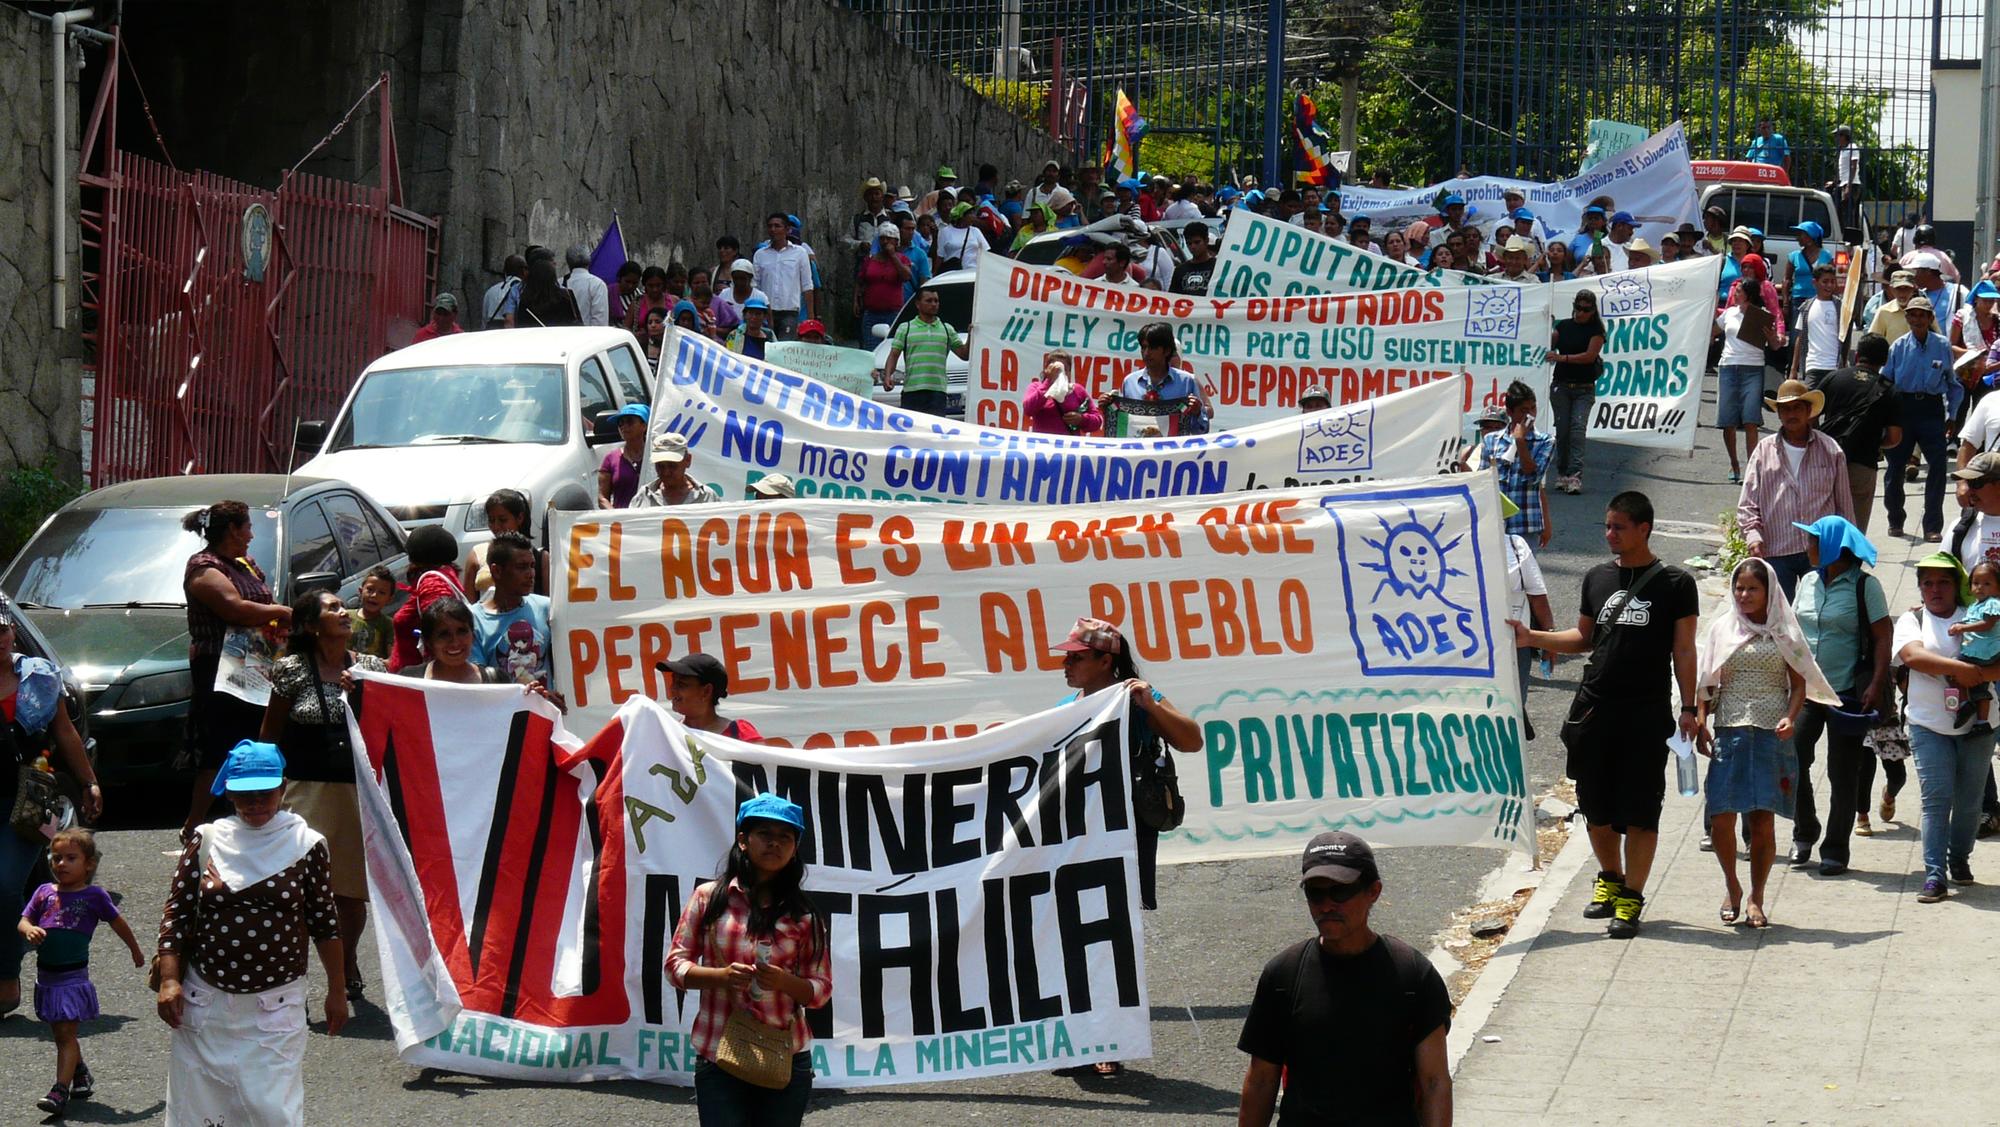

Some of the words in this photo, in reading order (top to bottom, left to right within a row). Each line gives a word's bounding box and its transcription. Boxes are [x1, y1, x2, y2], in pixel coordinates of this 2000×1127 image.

[1530, 186, 1573, 203] minería
[1008, 267, 1194, 318] DIPUTADAS
[1210, 300, 1236, 320] Y
[1246, 290, 1446, 326] DIPUTADOS
[1610, 296, 1650, 313] ADES
[1107, 318, 1139, 352] de
[1175, 323, 1231, 357] GUA
[1246, 330, 1311, 361] para
[1321, 326, 1375, 362] USO
[1471, 316, 1516, 335] ADES
[672, 335, 915, 433] DIPUTADAS
[981, 348, 1019, 391] LA
[1595, 354, 1689, 397] BAÑAS
[798, 442, 868, 482] mas
[884, 445, 1229, 505] CONTAMINACIÓN
[1305, 443, 1365, 464] ADES
[568, 521, 637, 602] EL
[661, 512, 813, 600] AGUA
[836, 513, 922, 584] ES
[942, 520, 1035, 571] UN
[1047, 512, 1182, 563] BIEN
[1197, 498, 1314, 557] QUE
[568, 595, 946, 707] PERTENECE
[980, 587, 1067, 672] AL
[1089, 578, 1314, 662] PUEBLO
[1371, 612, 1479, 661] ADES
[1204, 694, 1526, 808] PRIVATIZACIÓN
[731, 718, 1128, 876] MINERÍA
[846, 1043, 897, 1078] LA
